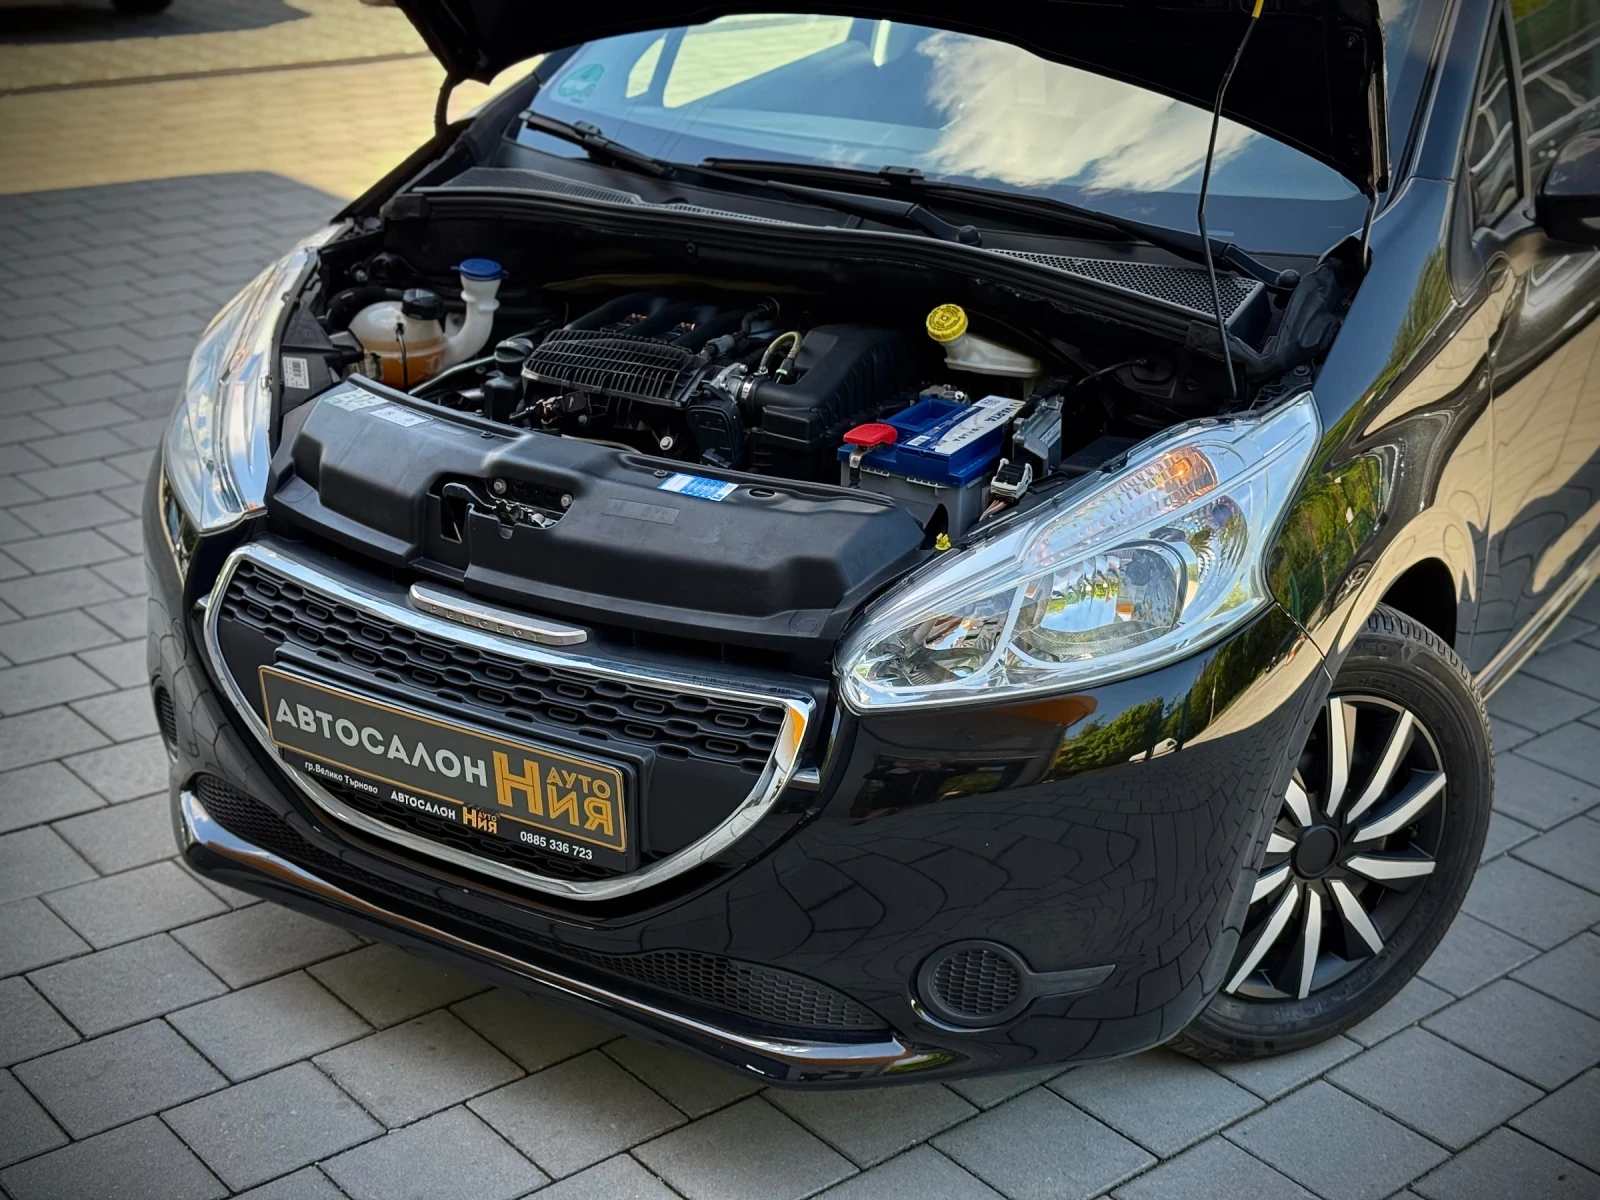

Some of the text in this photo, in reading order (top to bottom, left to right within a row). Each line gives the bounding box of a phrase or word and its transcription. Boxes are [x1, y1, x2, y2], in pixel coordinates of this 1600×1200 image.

[984, 407, 1016, 422] VARTA
[429, 605, 541, 642] PEUGEOT
[276, 698, 488, 788] АВТОСАЛОН
[344, 774, 379, 794] Търново
[546, 766, 611, 799] АУТО
[390, 790, 456, 820] АВТОСАЛОН
[519, 831, 594, 861] 0885 336 723
